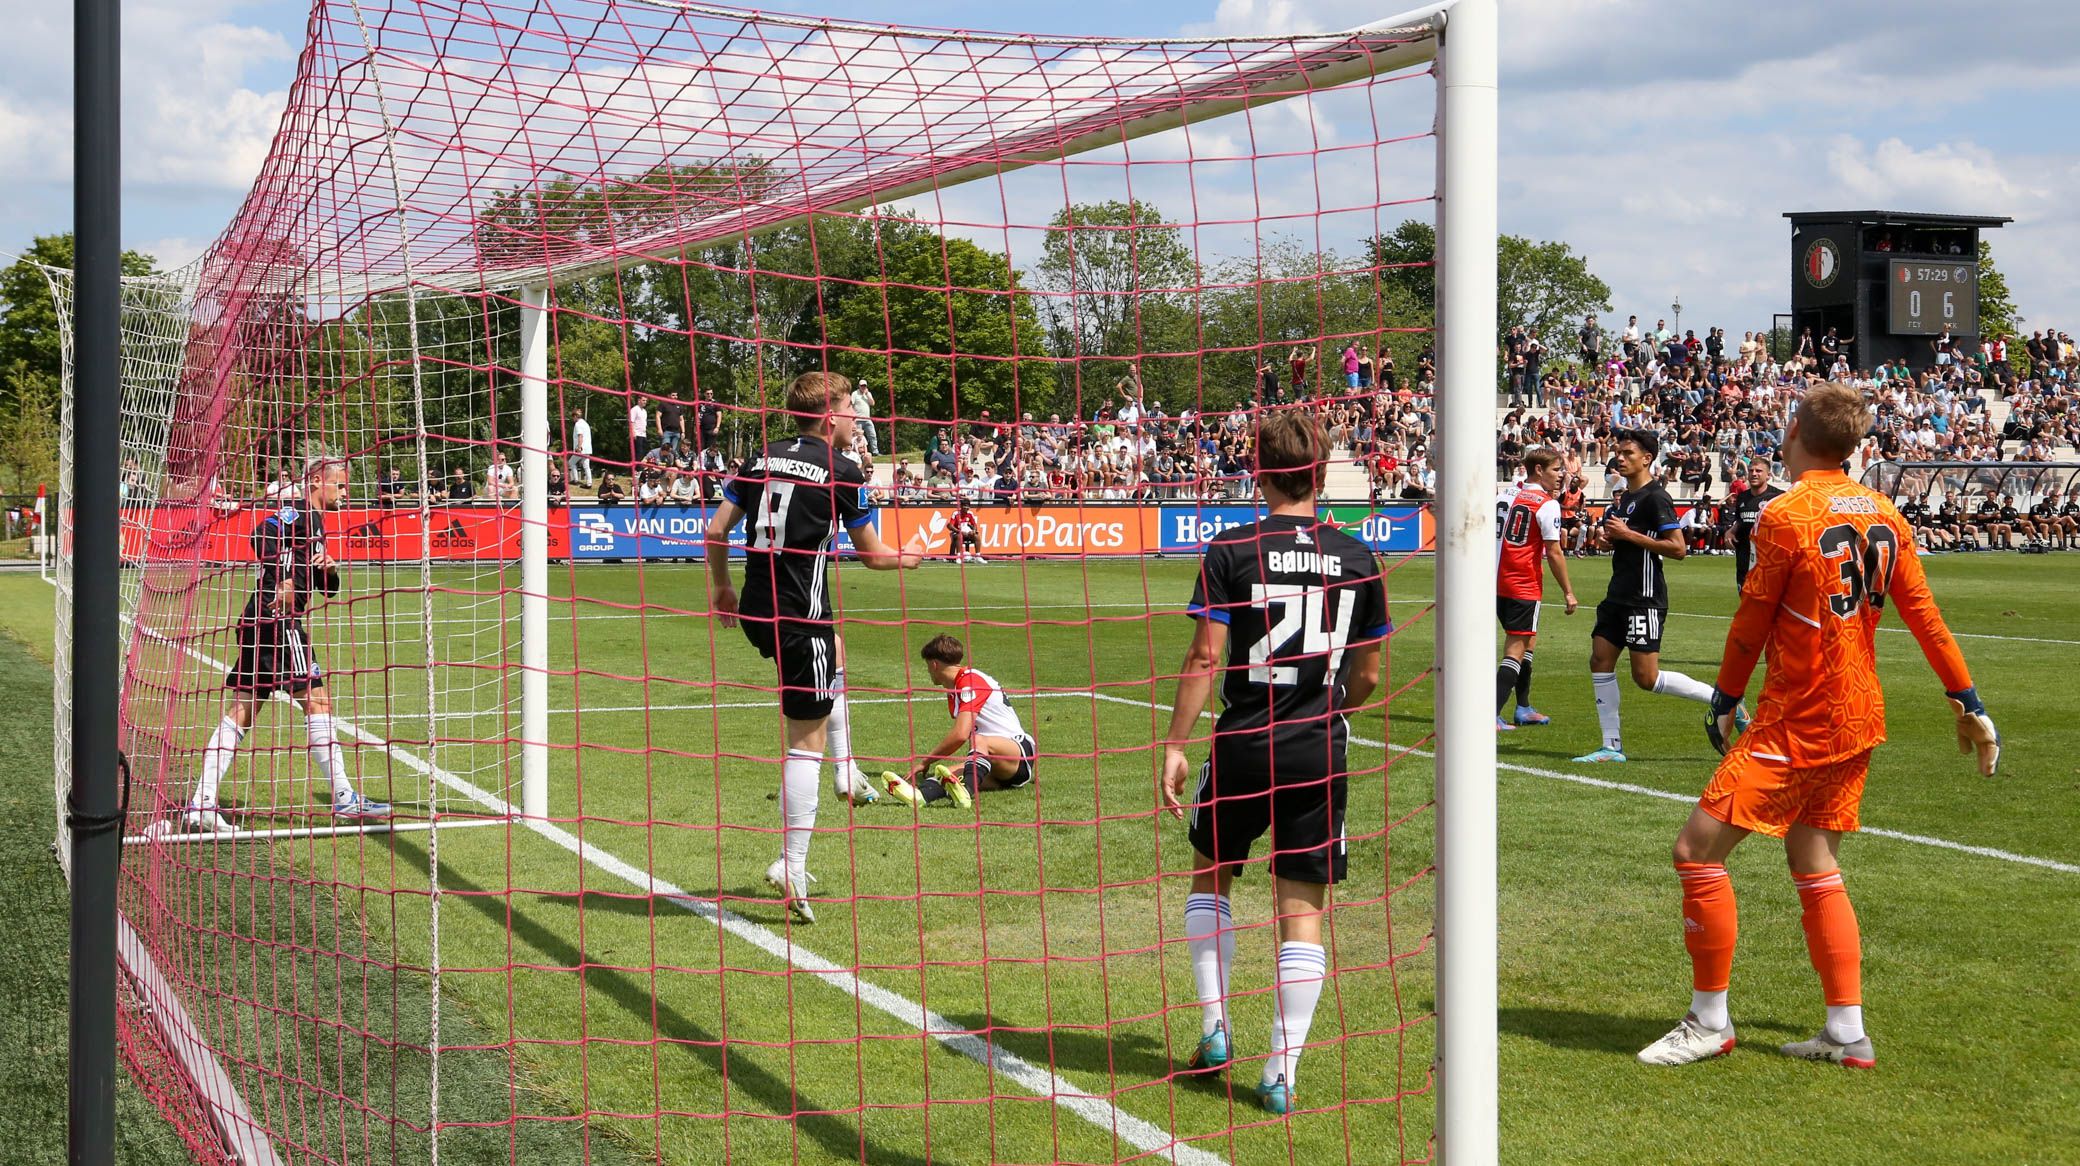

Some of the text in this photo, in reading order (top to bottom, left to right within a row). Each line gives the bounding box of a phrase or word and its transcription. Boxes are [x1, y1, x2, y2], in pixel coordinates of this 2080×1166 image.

[1917, 268, 1948, 281] 57:29
[1910, 290, 1954, 318] 0 6
[1829, 496, 1879, 514] JANSEN
[625, 518, 664, 534] VAN
[976, 515, 1123, 547] uroParcs
[346, 537, 390, 548] adidas
[431, 537, 475, 548] adidas
[1268, 550, 1342, 576] BØVING
[1818, 523, 1898, 621] 30
[1249, 584, 1356, 685] 24
[1627, 615, 1647, 635] 35
